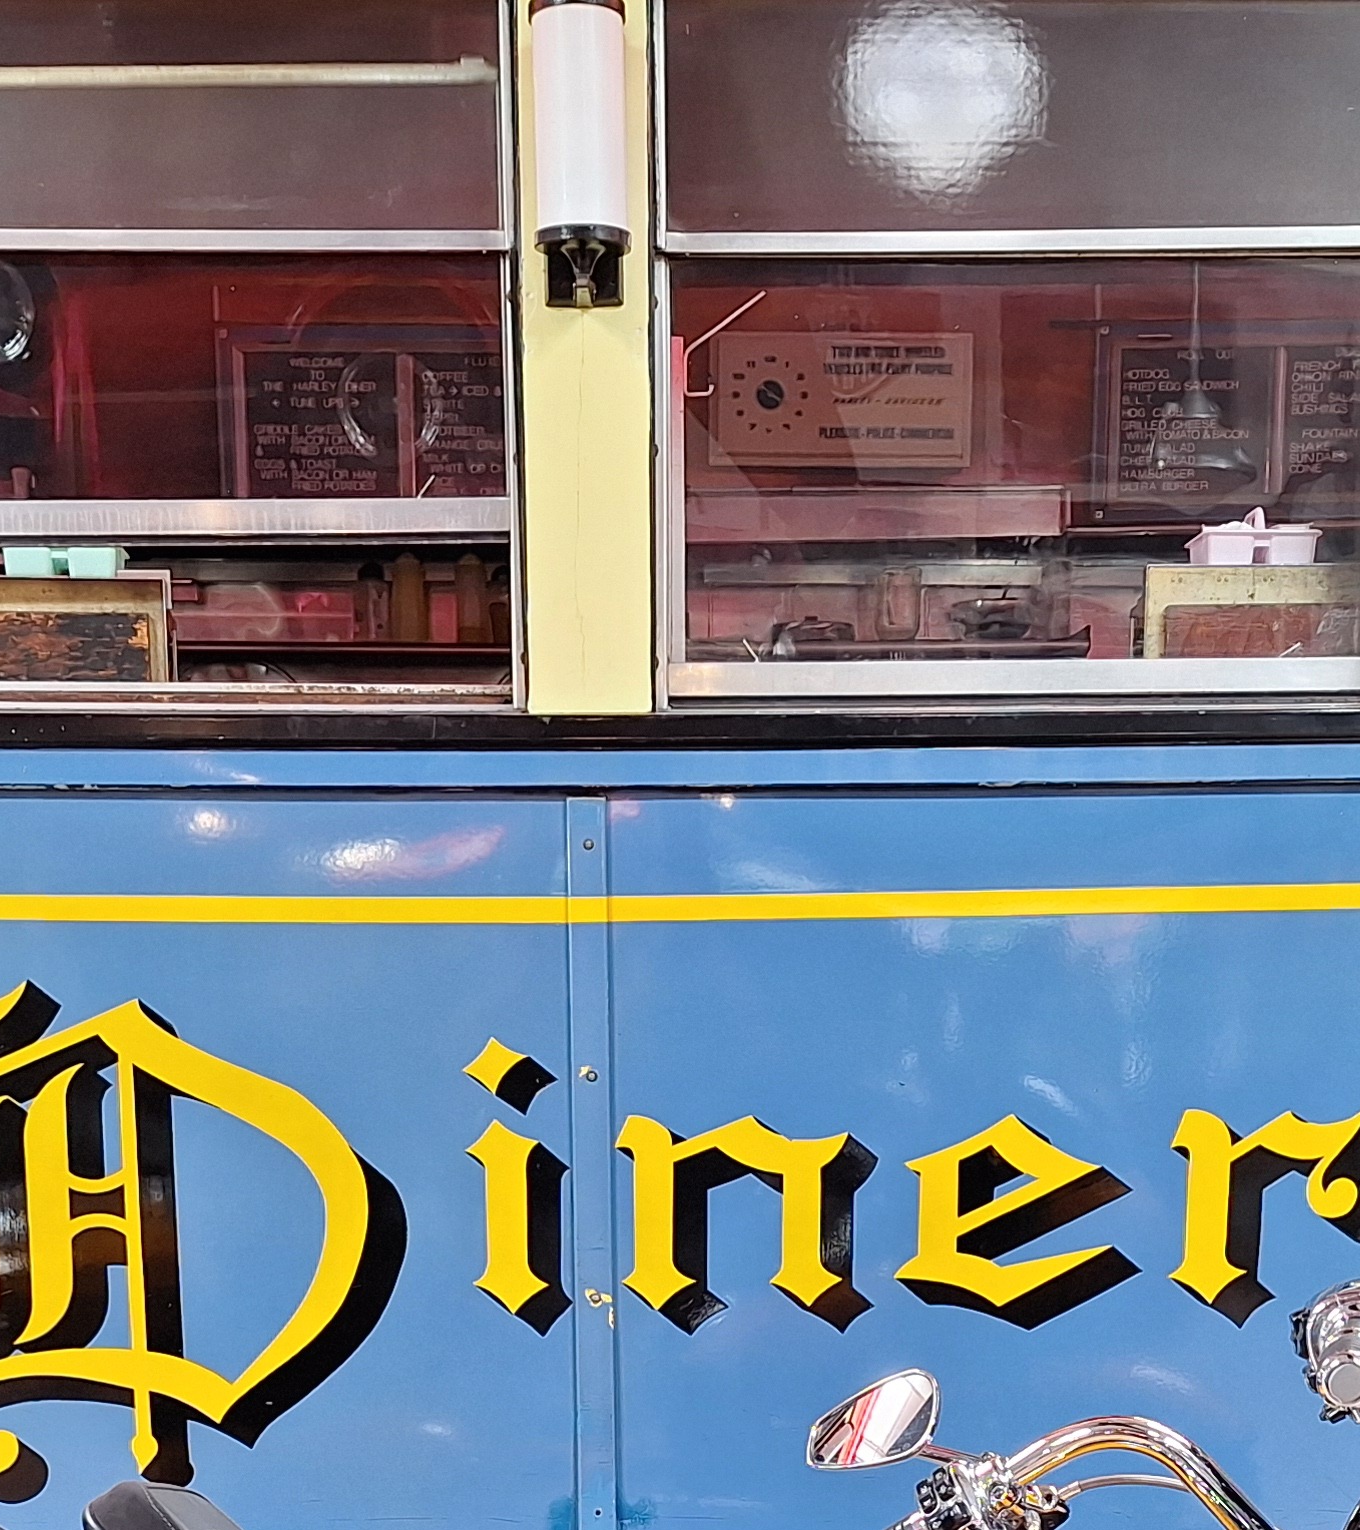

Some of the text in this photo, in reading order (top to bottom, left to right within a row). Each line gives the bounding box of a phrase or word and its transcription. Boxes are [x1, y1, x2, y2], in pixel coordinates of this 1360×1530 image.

[290, 357, 345, 368] WELCOME
[311, 370, 325, 380] TO
[422, 371, 469, 382] COFFEE
[1123, 369, 1170, 379] HOTDOG
[263, 382, 284, 392] THE
[293, 382, 337, 392] HARLEY
[1123, 380, 1240, 391] FRIED EGG SANDWICH
[1292, 383, 1324, 393] CHILI
[1291, 393, 1319, 403] SIDE
[1122, 408, 1146, 417] HOG
[1122, 419, 1217, 430] GRILLED CHEESE
[1126, 430, 1153, 440] WITH
[1157, 430, 1201, 440] TOMATO
[1212, 430, 1249, 439] BACON
[1302, 428, 1358, 438] FOUNTAIN
[257, 435, 286, 445] WITH
[301, 459, 337, 470] TOAST
[260, 470, 288, 480] WITH
[1121, 469, 1195, 479] HAMBURGER
[1162, 481, 1209, 491] BURGER
